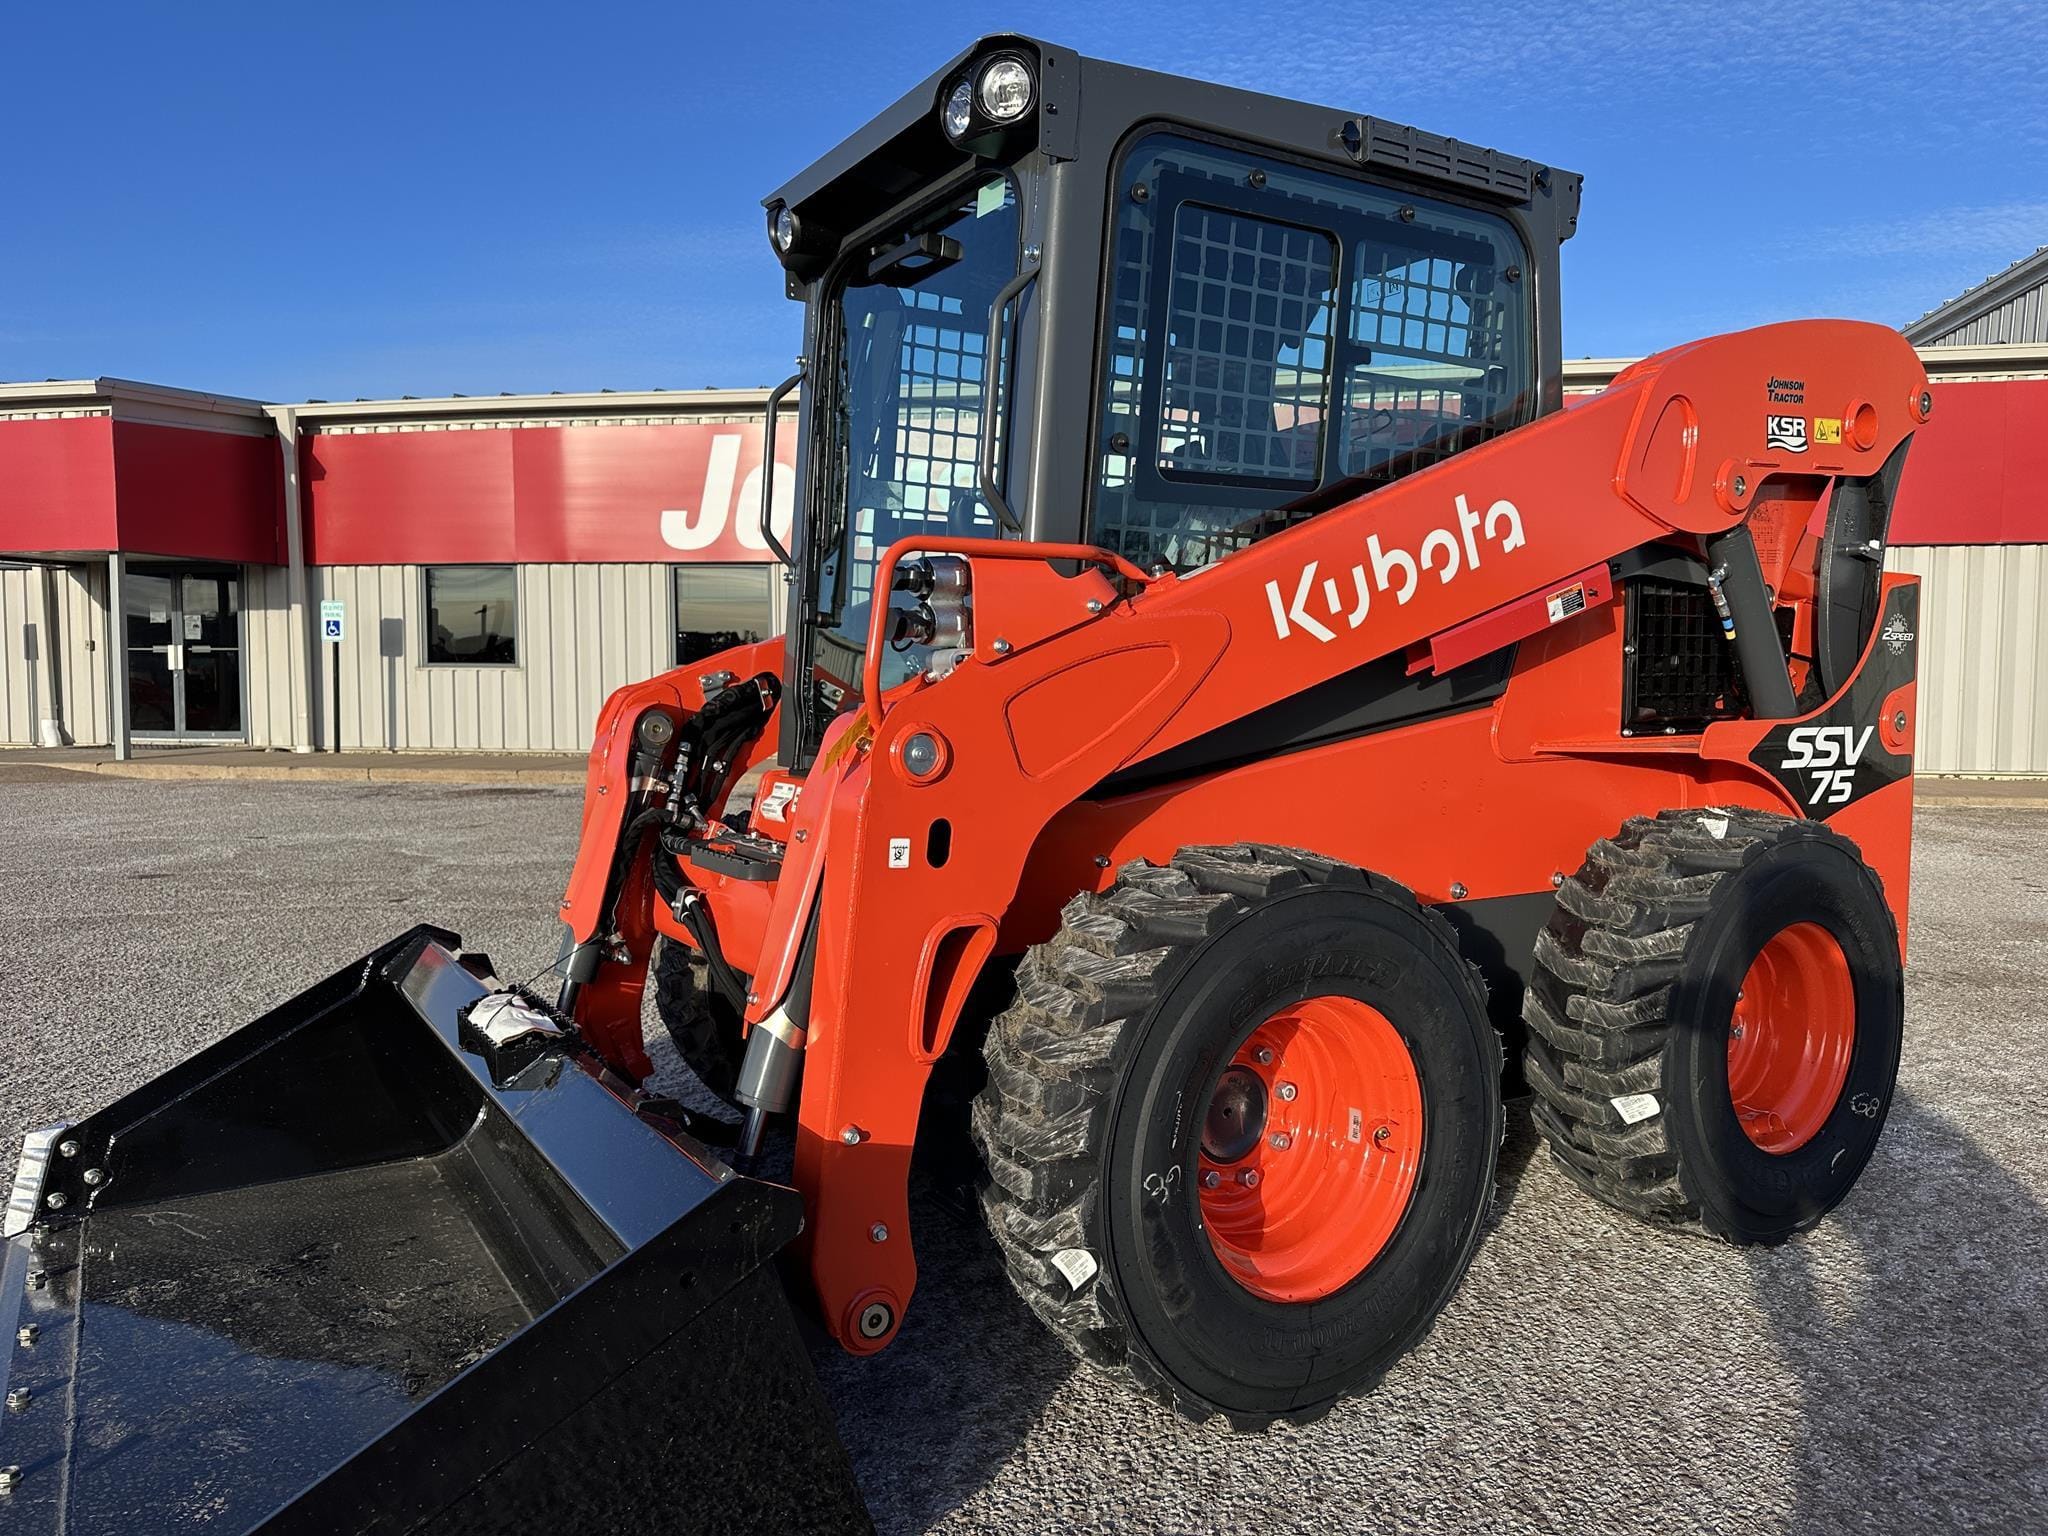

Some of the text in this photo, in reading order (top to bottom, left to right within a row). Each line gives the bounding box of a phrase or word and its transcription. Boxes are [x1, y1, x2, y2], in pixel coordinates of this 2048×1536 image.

[1767, 376, 1804, 391] JOHNSON
[1767, 389, 1804, 404] TRACTOR
[1767, 416, 1806, 436] KSR
[1264, 493, 1526, 643] Kubota
[1780, 725, 1875, 769] SSV
[1808, 769, 1856, 805] 75
